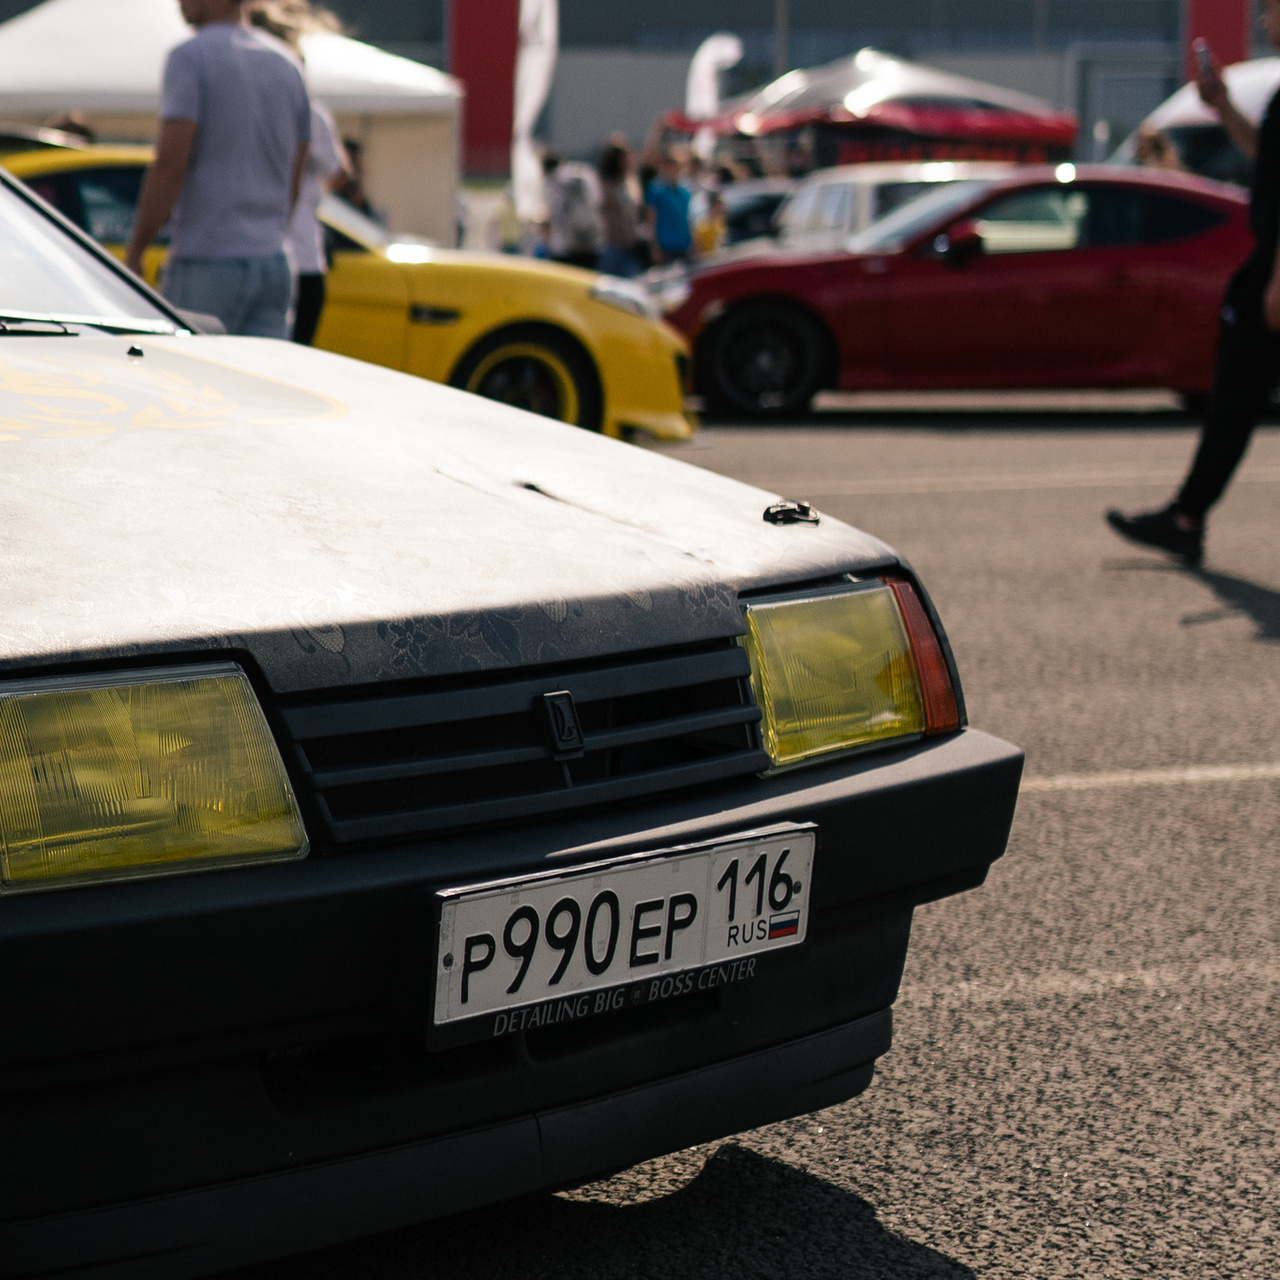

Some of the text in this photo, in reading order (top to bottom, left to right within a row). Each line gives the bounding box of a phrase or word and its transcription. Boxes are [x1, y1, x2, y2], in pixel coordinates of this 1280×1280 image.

[716, 848, 794, 922] 116
[727, 919, 768, 948] RUS
[493, 957, 757, 1037] DETAILING BIG BOSS CENTER
